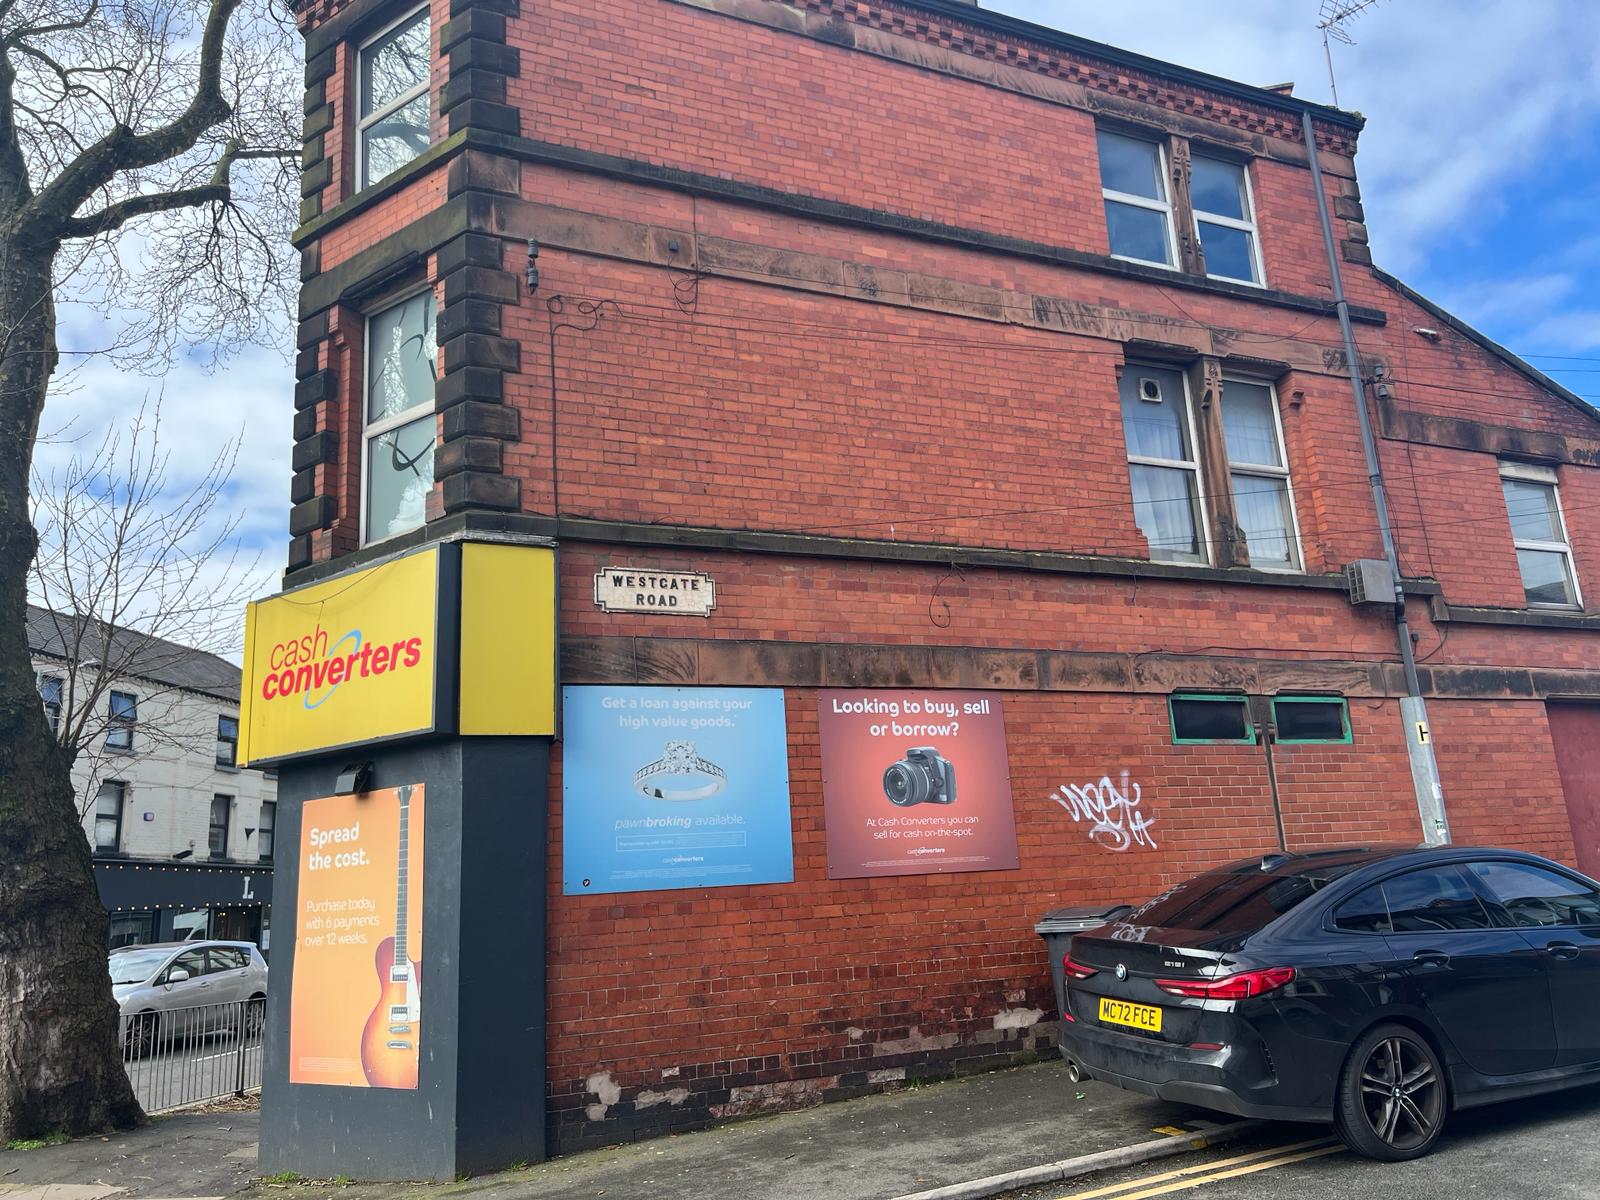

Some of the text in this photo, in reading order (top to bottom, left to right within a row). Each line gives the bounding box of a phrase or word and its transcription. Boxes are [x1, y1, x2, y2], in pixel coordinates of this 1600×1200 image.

[612, 575, 700, 591] WESTGATE
[636, 593, 678, 607] ROAD
[270, 623, 328, 671] cash
[262, 637, 422, 701] converters
[602, 697, 752, 711] Get a loan against your
[832, 698, 990, 717] Looking to buy, sell
[619, 714, 649, 730] high
[652, 714, 688, 728] value
[869, 720, 960, 737] or borrow?
[614, 814, 746, 831] pawnbroking available.
[866, 815, 979, 828] At Cash Converters you can
[309, 821, 360, 849] Spread
[873, 830, 888, 840] sell
[889, 829, 902, 839] for
[903, 829, 923, 838] cash
[308, 848, 370, 870] the cost.
[242, 876, 254, 900] L
[306, 897, 376, 913] Purchase today
[305, 914, 381, 930] with 6 payments
[304, 932, 369, 946] over 12 weeks.
[1102, 1000, 1157, 1027] MC72 FCE
